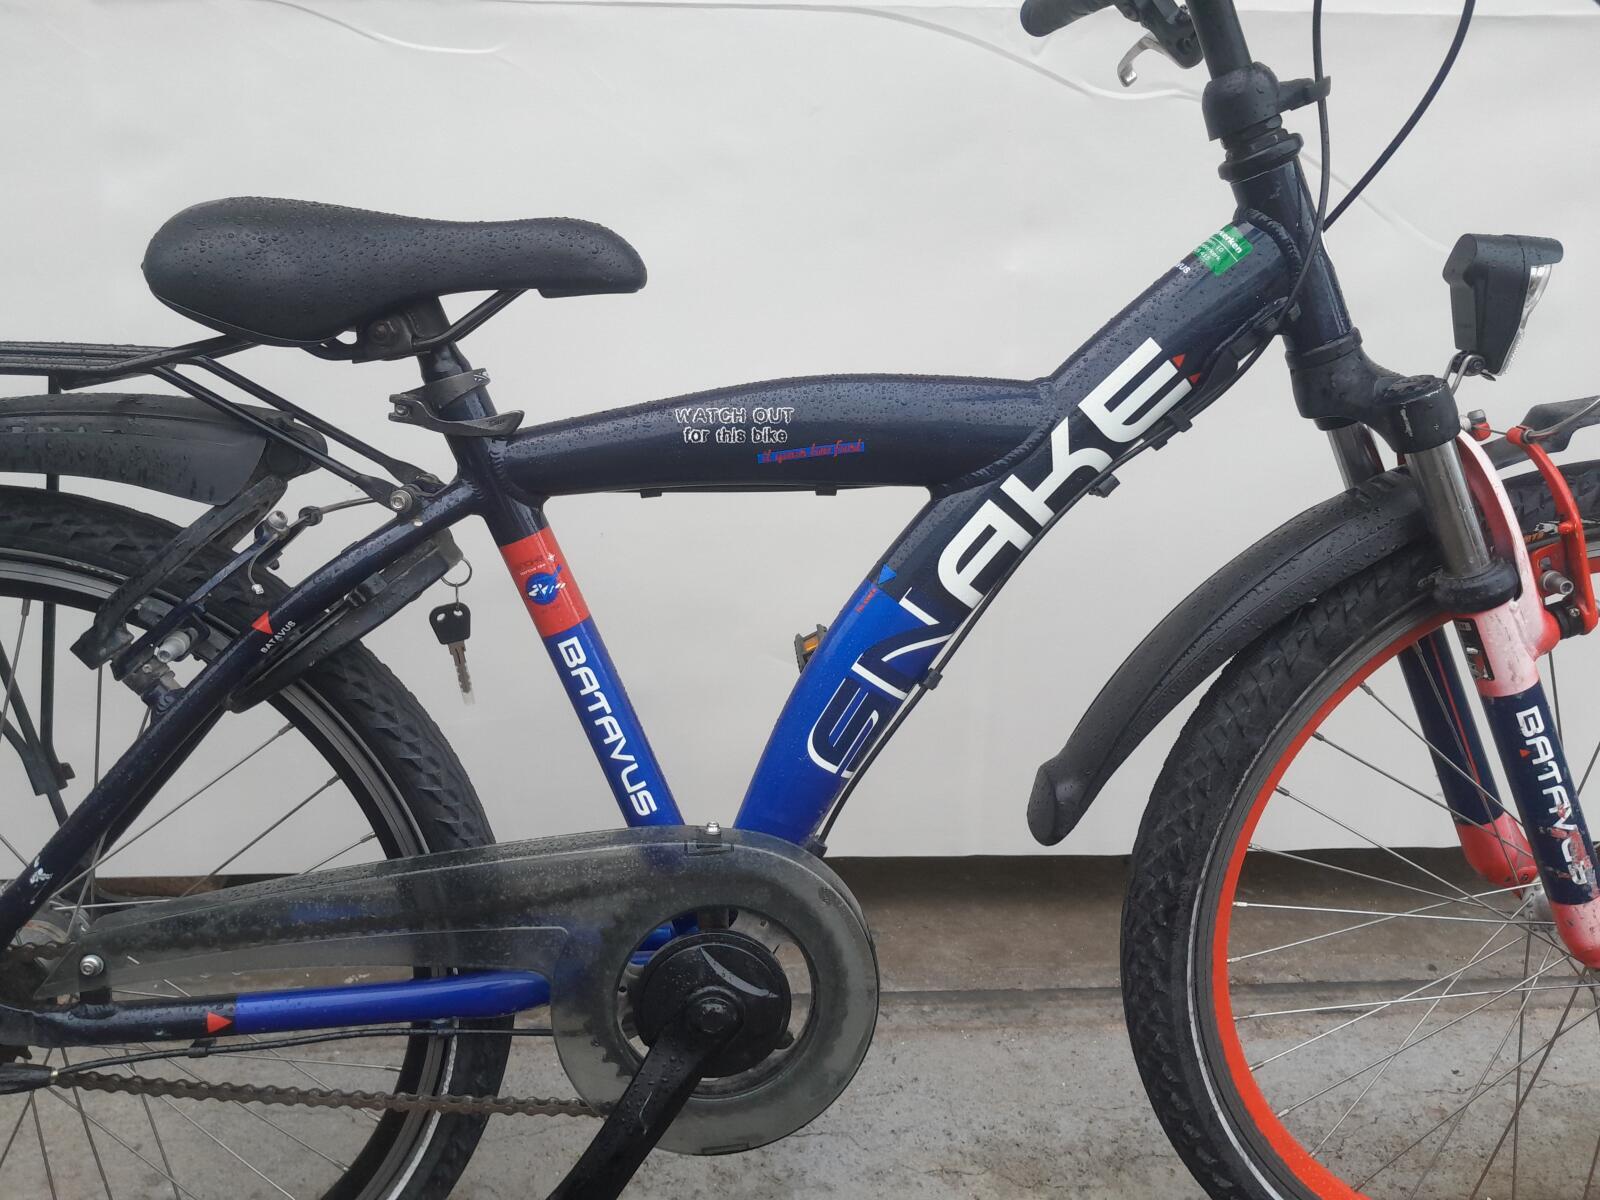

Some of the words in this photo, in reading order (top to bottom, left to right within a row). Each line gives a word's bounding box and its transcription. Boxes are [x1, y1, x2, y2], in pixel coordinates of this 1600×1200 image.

[675, 407, 746, 424] WATCH
[752, 407, 795, 424] OUT
[683, 427, 711, 443] for
[715, 426, 747, 443] this
[751, 427, 788, 443] bike
[807, 337, 1193, 779] SNAKE
[260, 620, 297, 653] BATAVUS
[557, 635, 658, 817] BATAVUS
